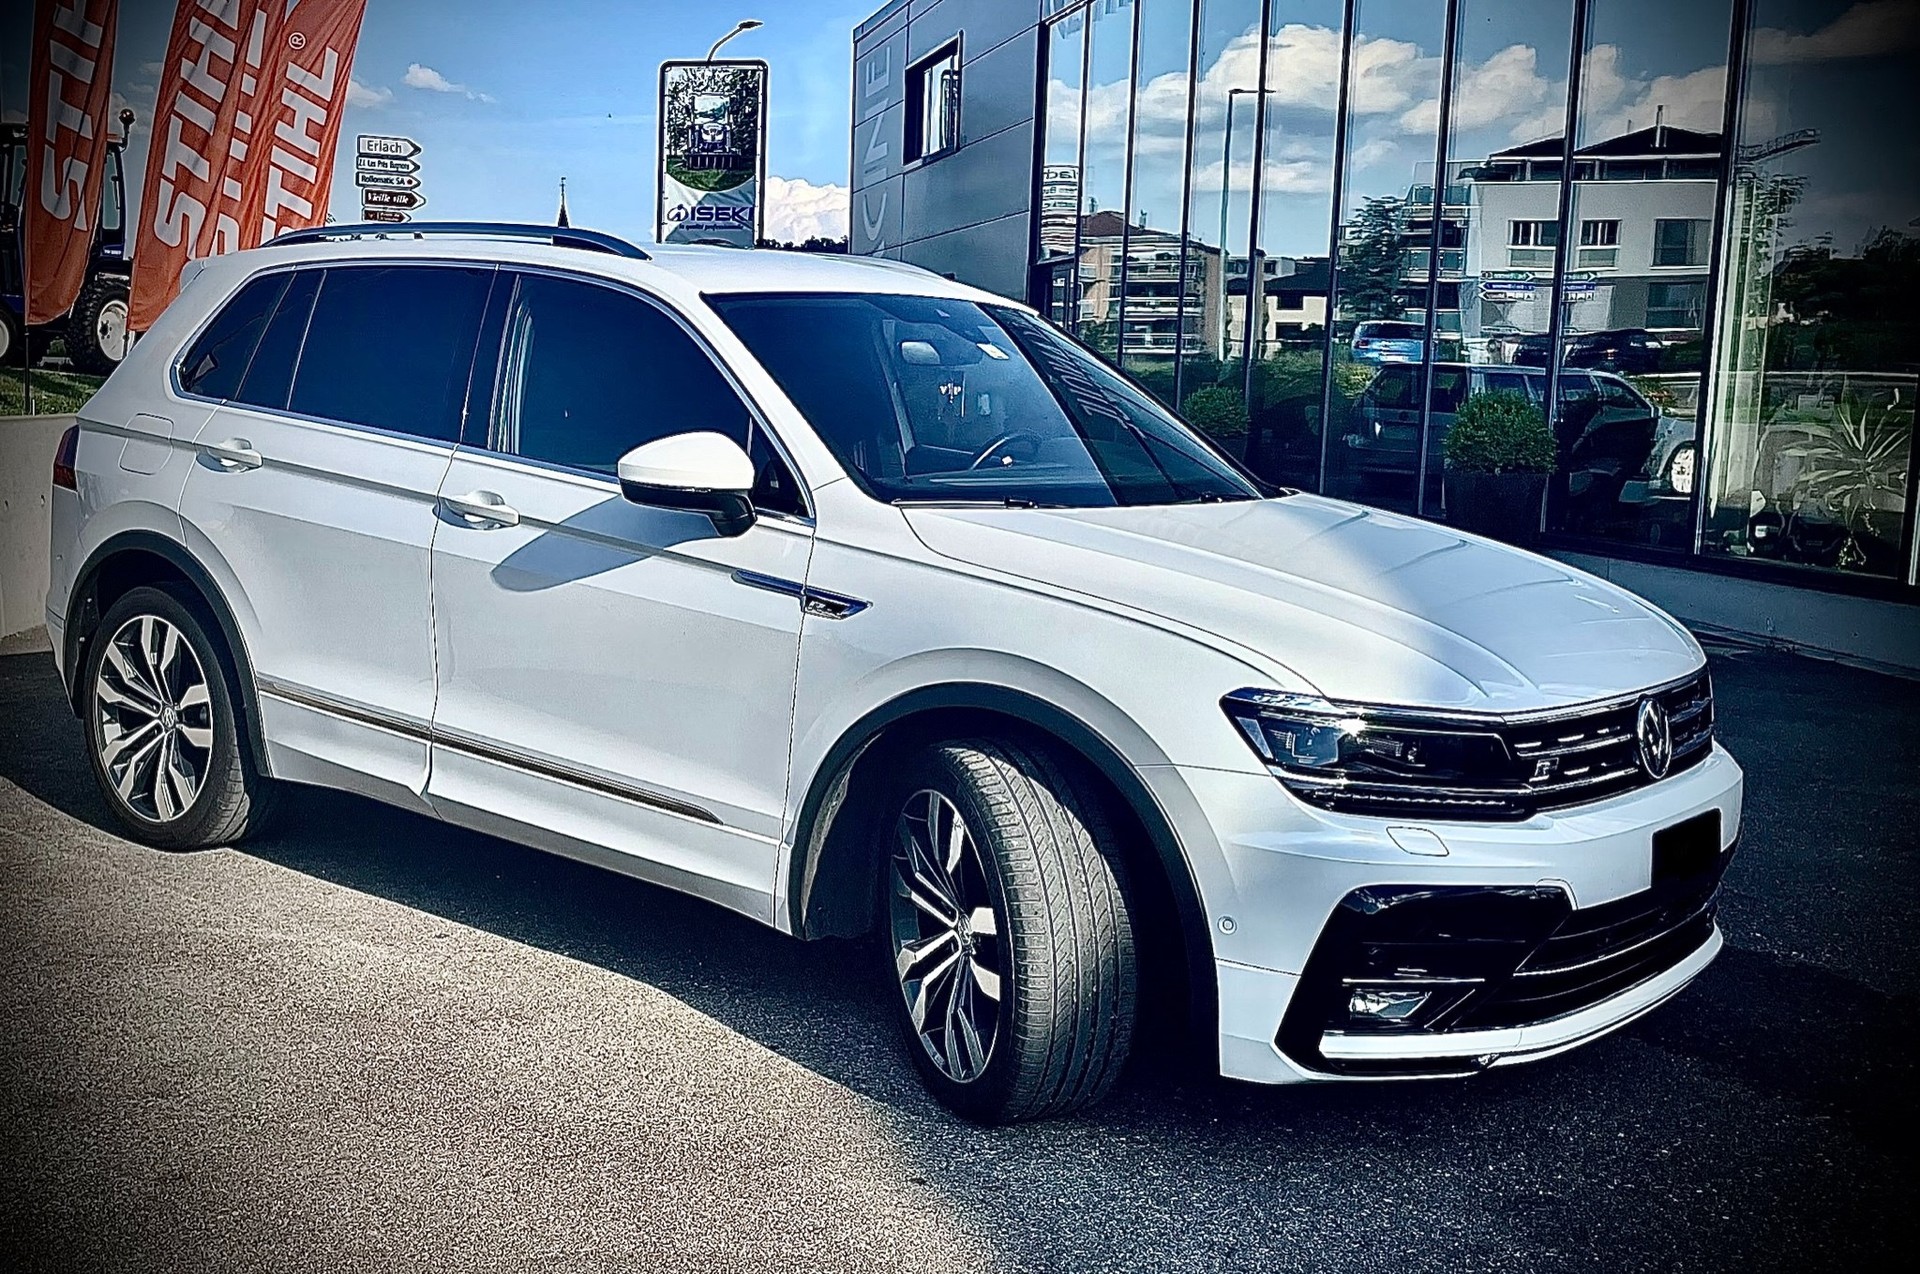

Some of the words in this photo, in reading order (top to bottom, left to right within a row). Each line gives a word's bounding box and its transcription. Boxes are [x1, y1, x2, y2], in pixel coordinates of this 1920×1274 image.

[366, 140, 402, 154] Erlach
[395, 177, 406, 186] SA
[690, 206, 756, 222] ISEKI
